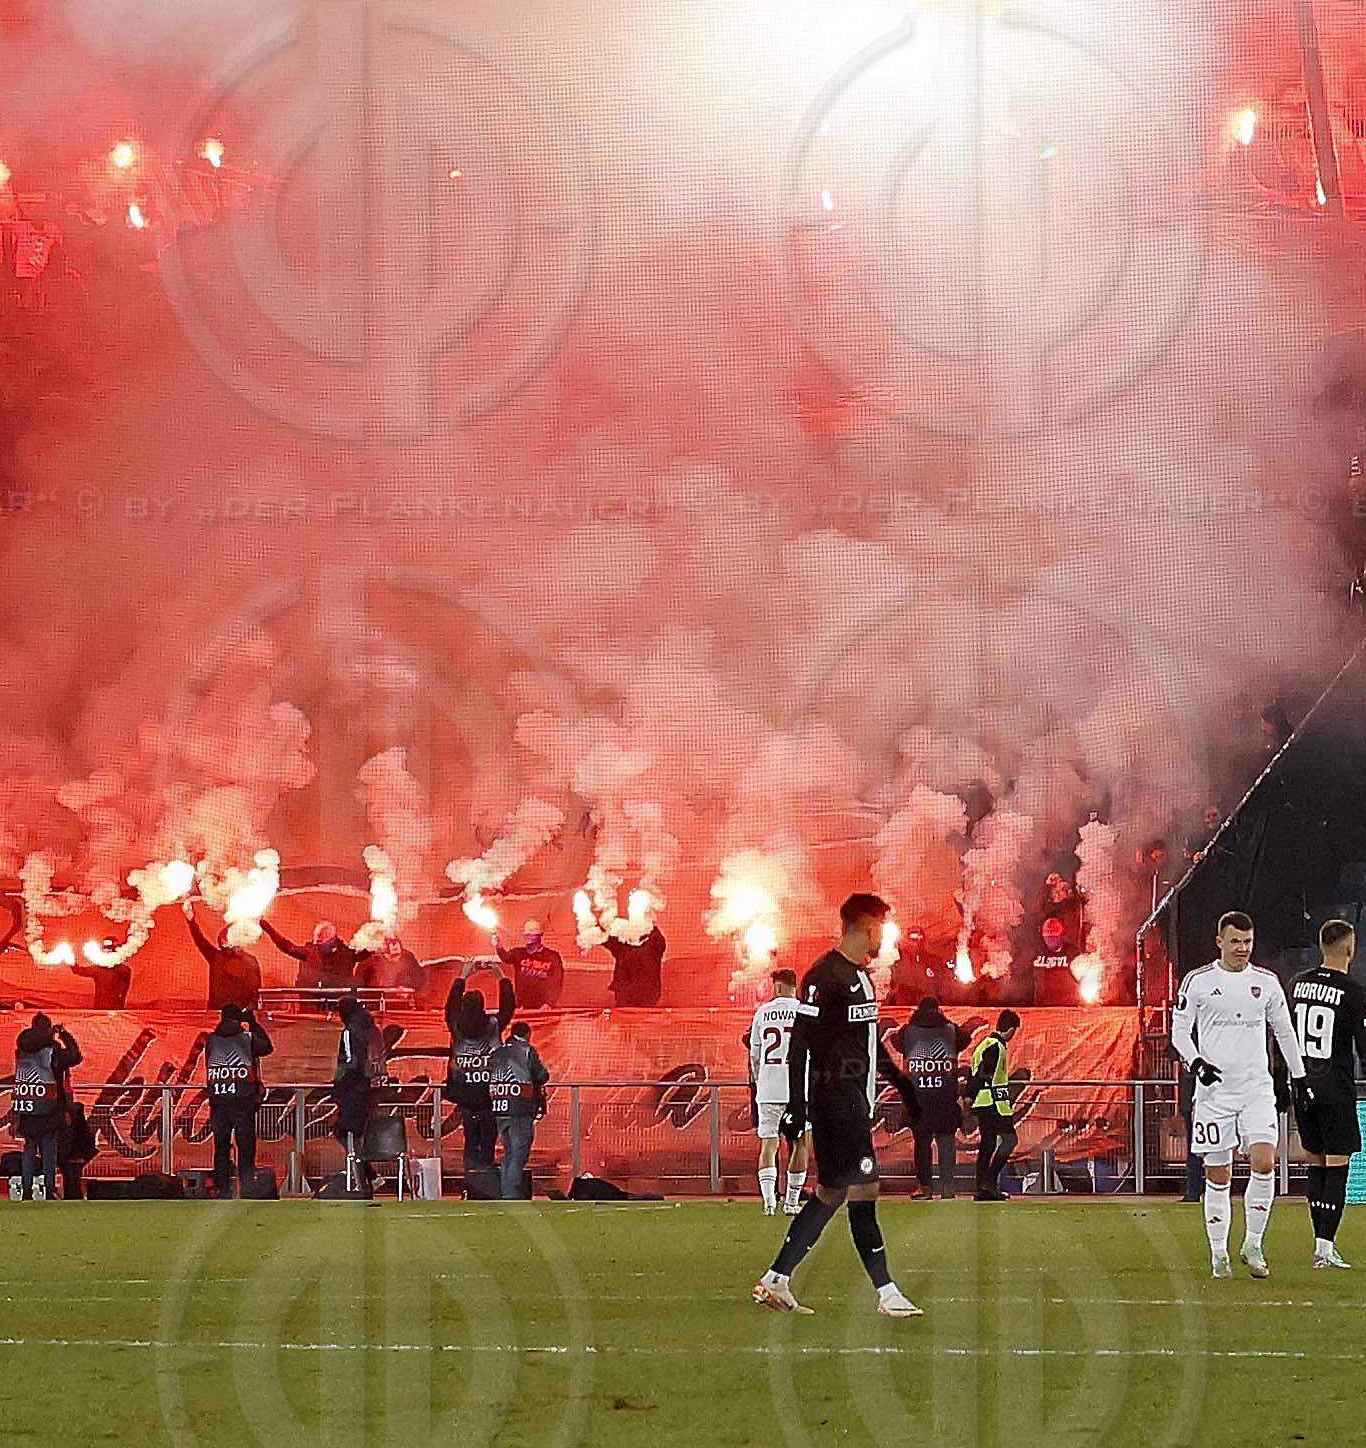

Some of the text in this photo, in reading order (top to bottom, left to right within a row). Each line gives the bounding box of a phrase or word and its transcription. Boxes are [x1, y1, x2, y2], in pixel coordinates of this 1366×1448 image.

[1293, 981, 1345, 1006] HORVAT
[763, 1010, 796, 1022] NOWA
[1294, 1003, 1336, 1059] 19
[457, 1055, 491, 1068] PHOT
[908, 1060, 952, 1073] PHOTO
[207, 1066, 248, 1081] PHOTO
[465, 1071, 490, 1083] 100
[918, 1076, 943, 1088] 115
[14, 1084, 46, 1097] HOTO
[213, 1083, 236, 1095] 114
[1195, 1121, 1221, 1145] 30
